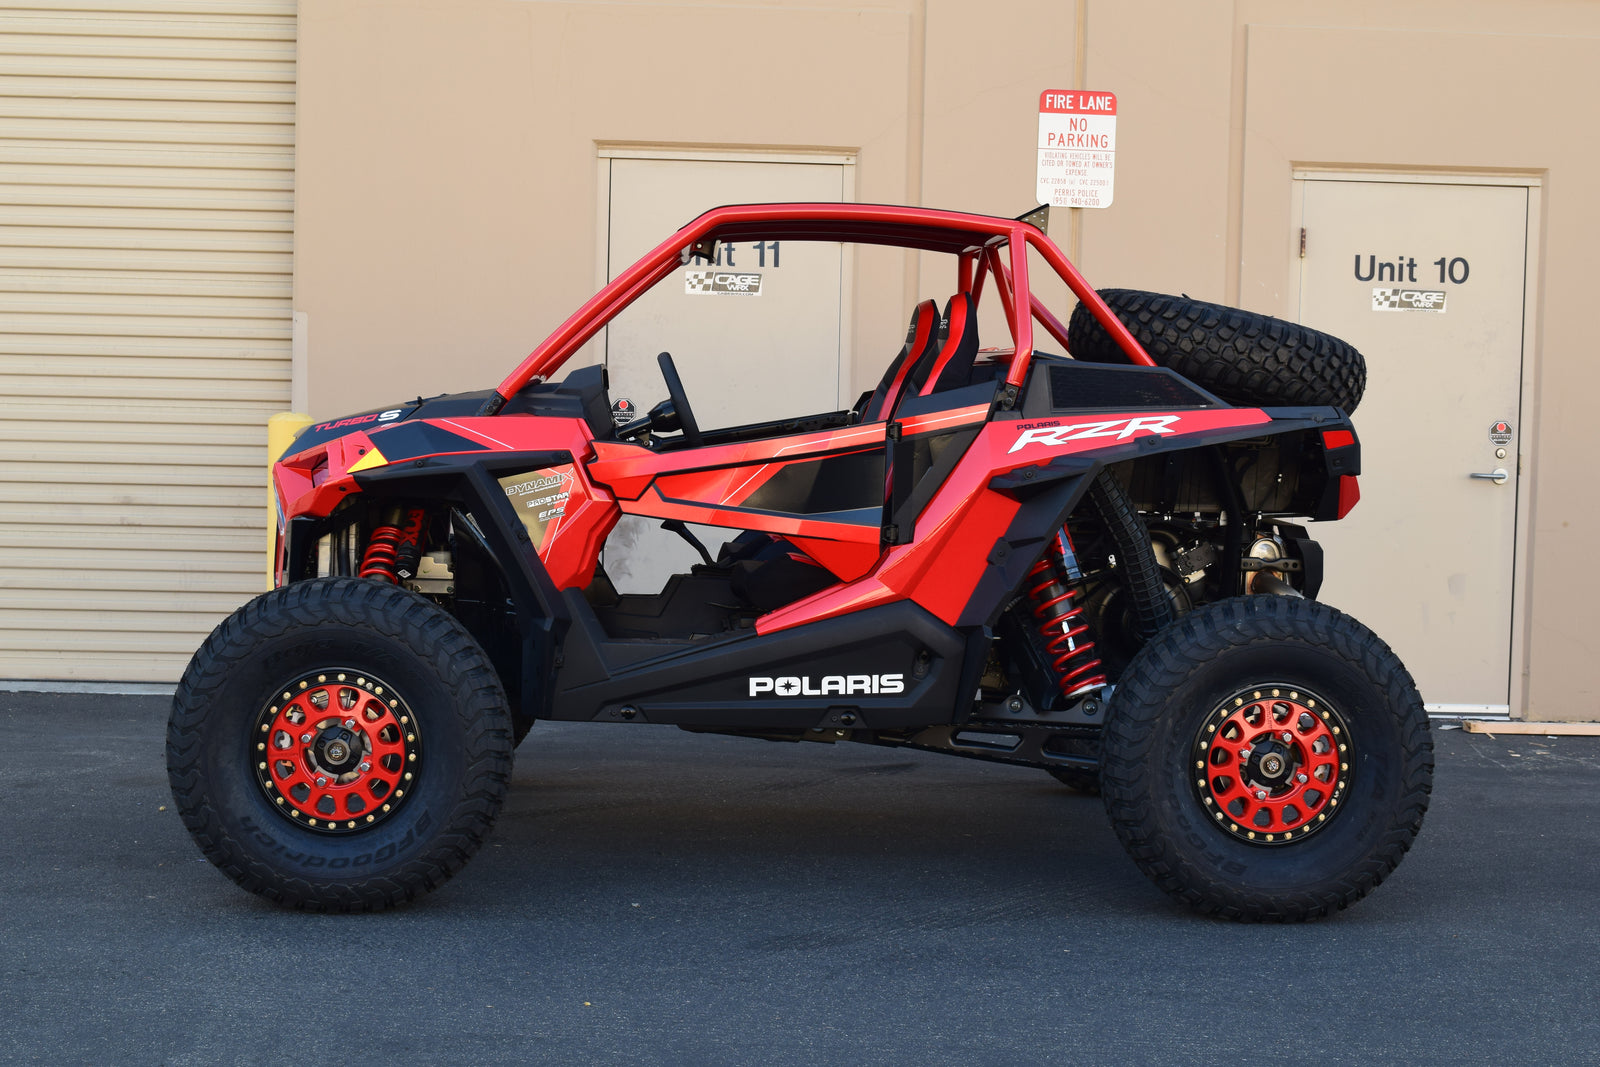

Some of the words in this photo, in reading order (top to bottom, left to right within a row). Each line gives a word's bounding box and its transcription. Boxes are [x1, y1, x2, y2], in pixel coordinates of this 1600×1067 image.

[1045, 94, 1074, 109] FIRE
[1079, 95, 1113, 111] LANE
[1069, 117, 1088, 132] NO
[1047, 132, 1108, 148] PARKING
[1069, 152, 1091, 160] VEHICLES
[1104, 153, 1111, 161] BE
[1054, 188, 1075, 196] PERRIS
[1078, 189, 1098, 197] POLICE
[1071, 198, 1100, 206] 940-6200
[753, 241, 779, 268] 11
[1354, 254, 1417, 282] Unit
[1433, 256, 1470, 284] 10
[714, 274, 760, 285] CAGE
[1400, 291, 1445, 302] CAGE
[315, 413, 379, 432] TURBO
[377, 409, 402, 422] S
[1016, 420, 1061, 431] POLARIS
[1007, 415, 1182, 454] RZR
[505, 467, 575, 496] DYNAMIX
[526, 491, 570, 508] PROSTAR
[538, 506, 565, 518] EPS
[749, 673, 905, 697] POLARIS
